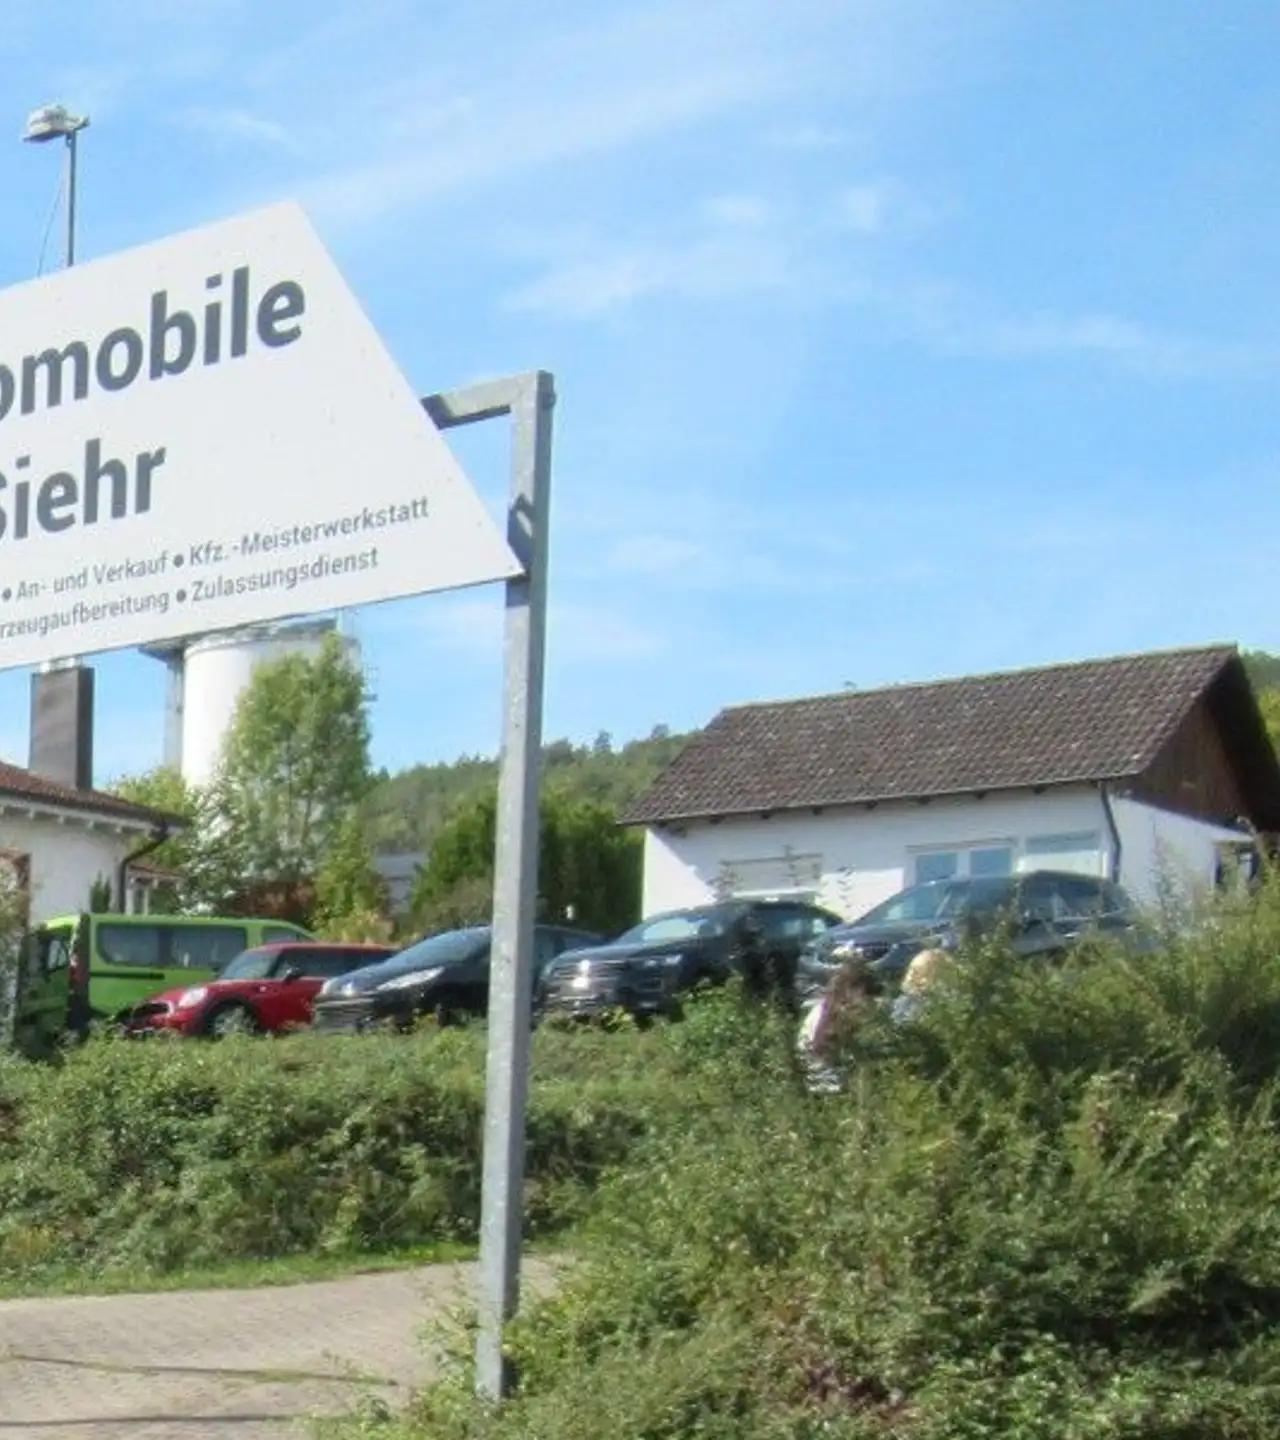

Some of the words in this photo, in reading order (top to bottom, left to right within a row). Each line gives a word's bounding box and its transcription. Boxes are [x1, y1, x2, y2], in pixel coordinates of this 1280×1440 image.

[16, 580, 46, 600] An-
[53, 569, 88, 592] und
[93, 550, 170, 585] Verkauf
[192, 546, 379, 602] Zulassungsdienst
